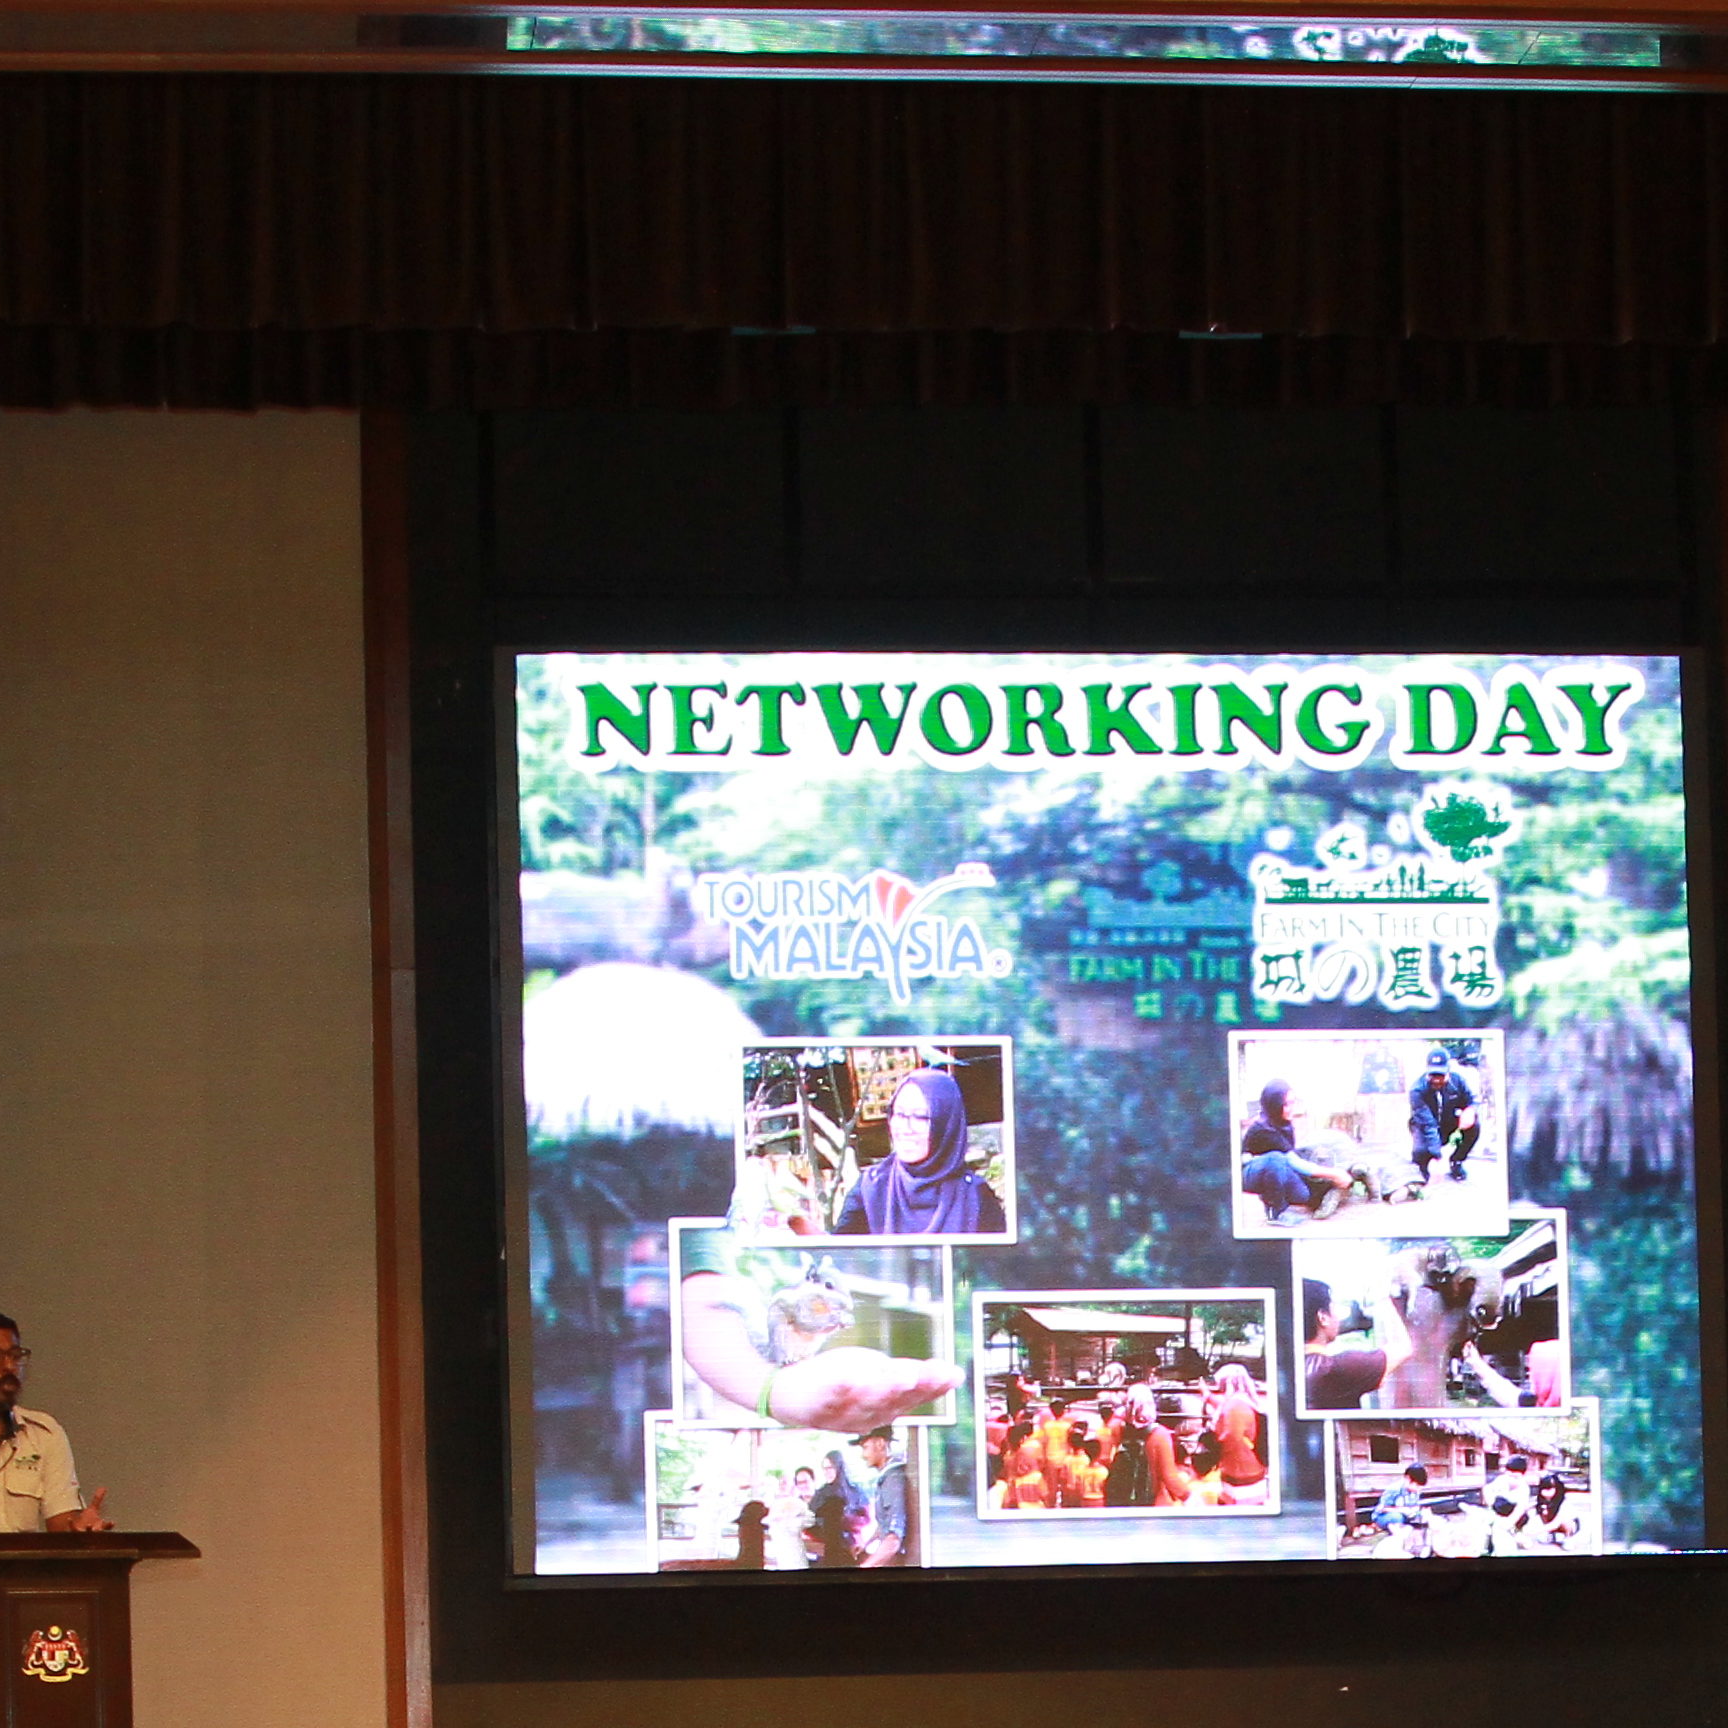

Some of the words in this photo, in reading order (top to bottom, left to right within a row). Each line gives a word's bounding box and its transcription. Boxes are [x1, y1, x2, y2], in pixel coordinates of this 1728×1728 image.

[577, 682, 1370, 755] NETWORKING
[1403, 682, 1632, 755] DAY
[703, 879, 871, 919] TOURISM
[1260, 913, 1327, 938] FARM
[1340, 913, 1364, 937] IN
[1373, 912, 1422, 936] THE
[1433, 912, 1493, 938] CITY
[735, 920, 984, 1000] MALAYSIA
